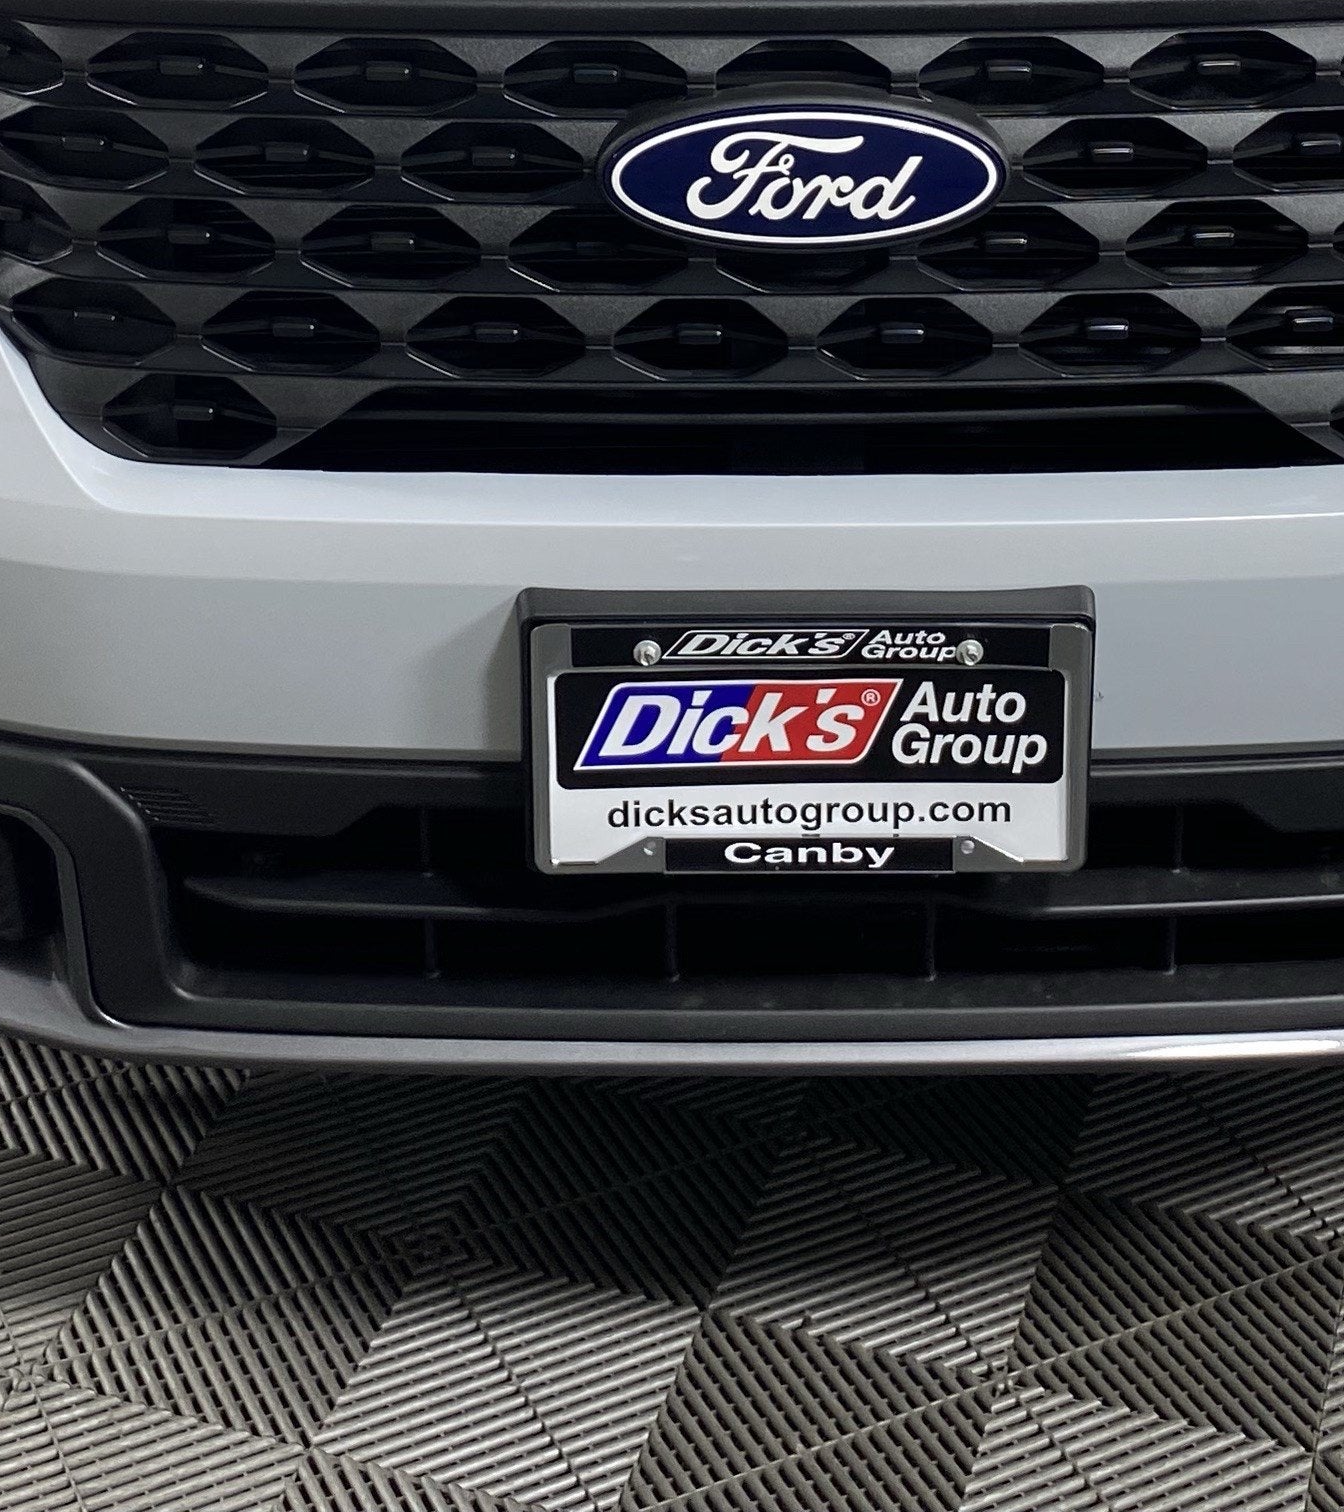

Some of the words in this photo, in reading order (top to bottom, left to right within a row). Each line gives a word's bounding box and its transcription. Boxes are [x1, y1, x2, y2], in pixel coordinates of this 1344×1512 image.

[685, 130, 924, 221] Ford
[860, 644, 957, 662] Group
[868, 629, 947, 645] Auto
[898, 680, 1027, 725] Auto
[891, 723, 1048, 775] Group
[606, 797, 1012, 832] dicksautogroup.com
[723, 842, 895, 868] Canby
